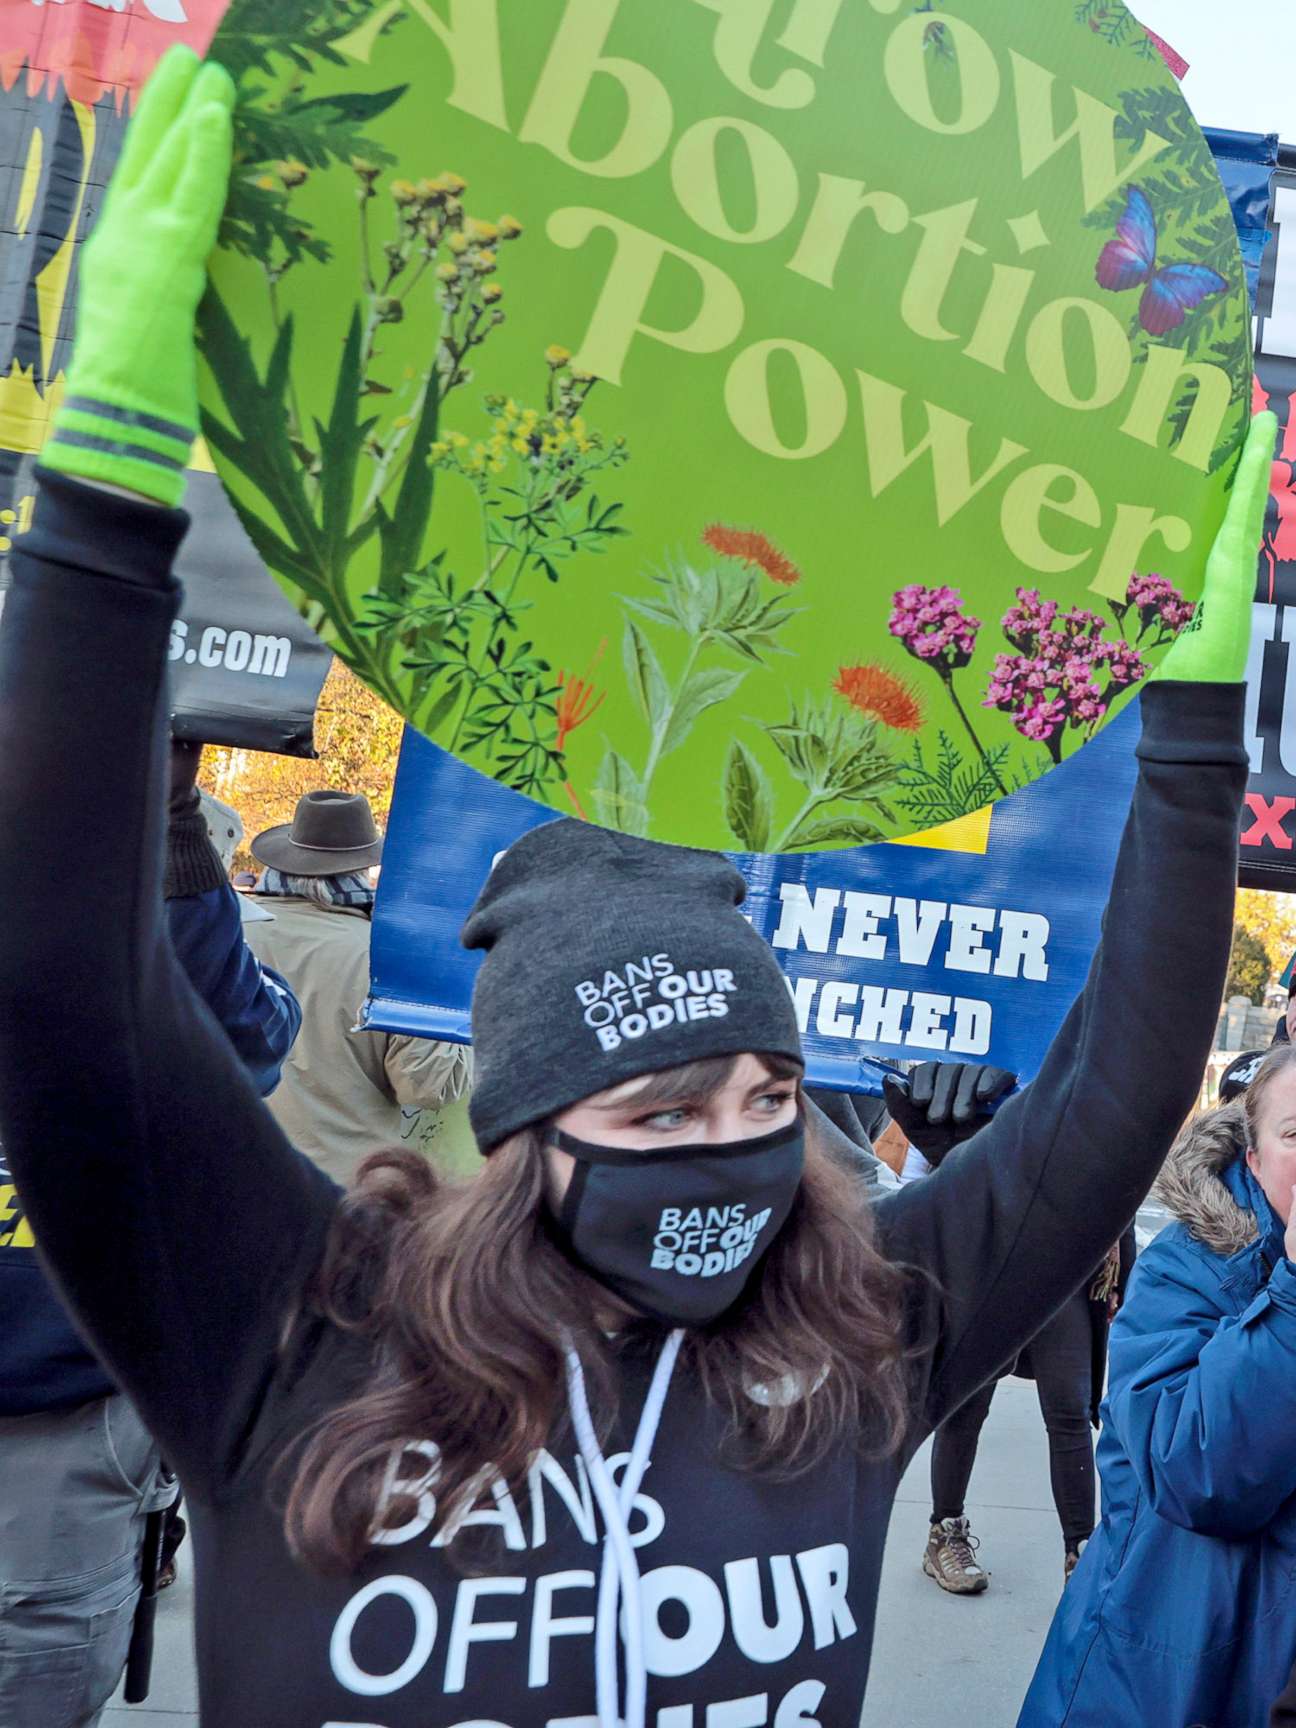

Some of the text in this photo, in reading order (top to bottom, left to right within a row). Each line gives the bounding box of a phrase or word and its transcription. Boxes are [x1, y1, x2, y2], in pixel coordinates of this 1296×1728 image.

[546, 205, 1191, 602] Power
[168, 619, 292, 678] s.com
[772, 882, 1051, 982] NEVER
[575, 953, 674, 1006] BANS
[584, 969, 738, 1028] OFF OUR
[596, 993, 730, 1051] BODIES
[784, 976, 993, 1056] NCHED
[653, 1228, 720, 1253] OFF
[659, 1203, 746, 1231] BANS
[366, 1439, 666, 1551] BANS
[330, 1542, 857, 1696] OFF OUR
